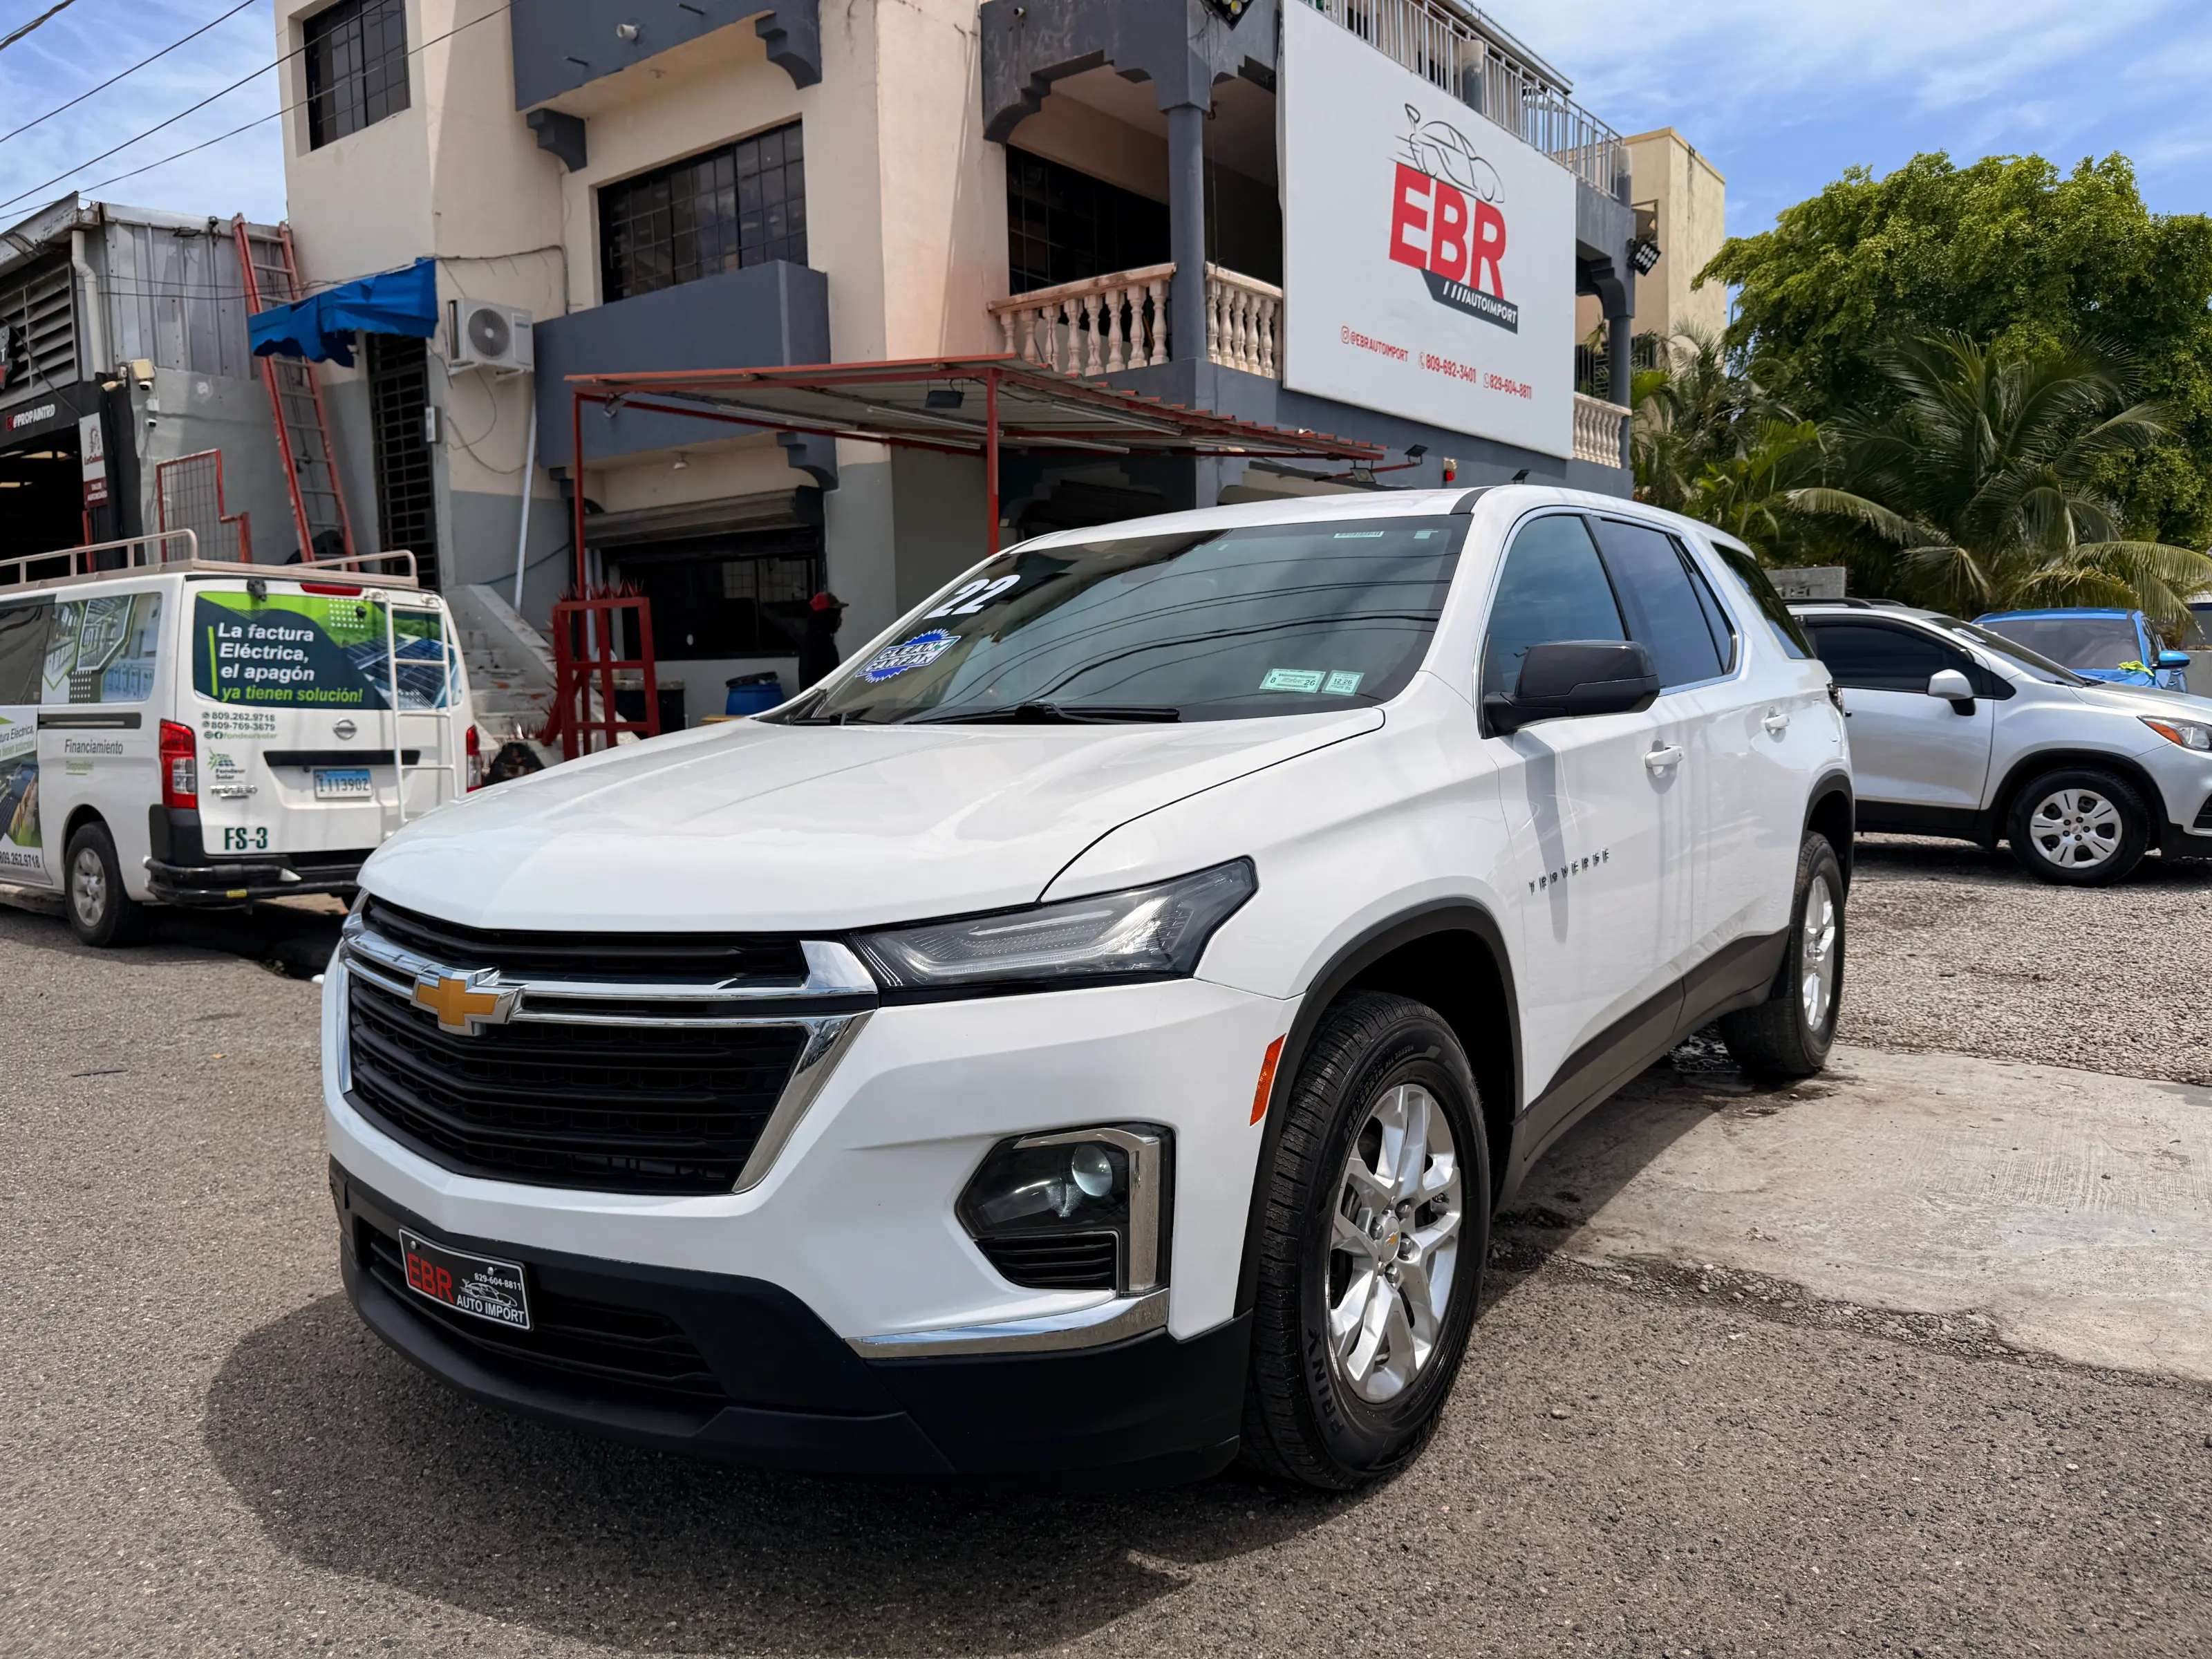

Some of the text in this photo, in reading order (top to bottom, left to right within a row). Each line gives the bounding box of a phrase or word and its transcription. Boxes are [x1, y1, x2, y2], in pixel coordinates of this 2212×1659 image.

[1389, 162, 1506, 300] EBR
[1465, 292, 1517, 324] AUTOIMPORT
[1350, 332, 1532, 400] @EBRAUTOIMPORT 809-692-3401 829-604-8811
[923, 574, 1021, 619] 22
[218, 622, 314, 641] La factura
[220, 643, 308, 663] Eléctrica,
[879, 643, 936, 659] CLEAN
[866, 654, 934, 672] CARFAX
[221, 664, 315, 684] el apagón
[222, 685, 363, 702] ya tienen solución!
[212, 712, 275, 722] 809.262.9718
[65, 738, 124, 754] Financiamiento
[225, 827, 268, 850] FS-3
[1528, 848, 1610, 894] TRAVERSE
[407, 1252, 524, 1323] EBR AUTO IMPORT
[474, 1273, 521, 1291] 829-604-8811
[1308, 1327, 1345, 1436] PRINX
